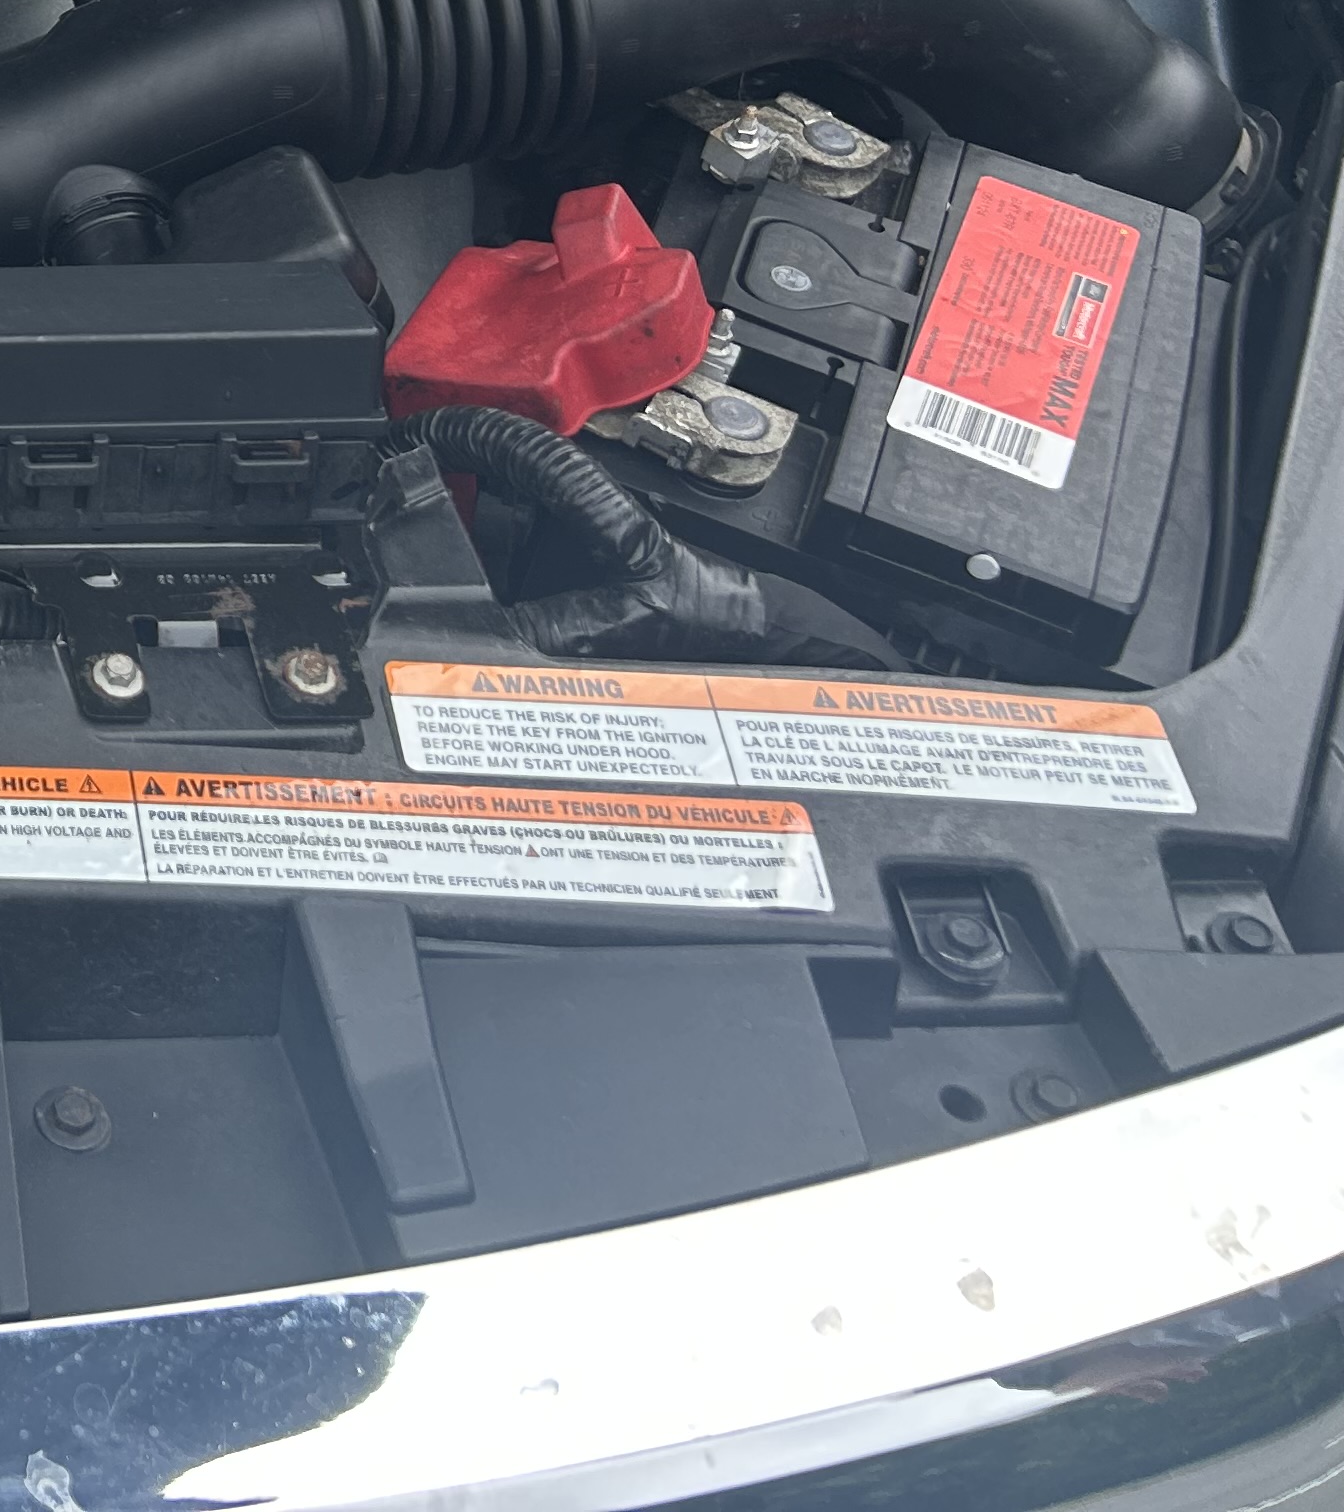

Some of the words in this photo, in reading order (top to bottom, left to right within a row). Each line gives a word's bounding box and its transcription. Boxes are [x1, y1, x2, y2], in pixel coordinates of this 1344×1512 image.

[1040, 375, 1080, 429] MAX
[496, 673, 625, 699] WARNING
[412, 704, 434, 717] TO
[437, 706, 502, 721] REDUCE
[504, 709, 537, 722] THE
[539, 710, 578, 724] RISK
[579, 712, 601, 725] OF
[845, 690, 1057, 724] AVERTISSEMENT
[417, 720, 483, 735] REMOVE
[485, 723, 517, 737] THE
[520, 726, 551, 739] KEY
[555, 727, 601, 741] FROM
[603, 729, 635, 742] THE
[637, 731, 707, 745] IGNITION
[735, 719, 781, 733] POUR
[782, 720, 851, 737] RÉDUIRE
[853, 725, 885, 739] LES
[886, 727, 955, 743] RISQUES
[957, 732, 980, 745] DE
[1079, 741, 1144, 757] RETIRER
[420, 736, 485, 751] BEFORE
[486, 740, 564, 755] WORKING
[566, 743, 622, 758] UNDER
[740, 735, 763, 748] LA
[764, 736, 796, 750] CLÉ
[798, 738, 821, 751] DE
[926, 746, 974, 761] AVANT
[976, 749, 1114, 770] D'ENTREPRENDRE
[1115, 759, 1148, 773] DES
[424, 752, 482, 767] ENGINE
[486, 755, 518, 769] MAY
[522, 757, 572, 771] START
[744, 751, 817, 766] TRAVAUX
[819, 755, 865, 770] SOUS
[866, 758, 888, 772] LE
[952, 763, 974, 776] LE
[975, 765, 1042, 781] MOTEUR
[1043, 769, 1083, 784] PEUT
[1087, 772, 1109, 786] SE
[1110, 774, 1172, 790] METTRE
[750, 767, 773, 780] EN
[775, 768, 844, 784] MARCHE
[175, 778, 376, 805] AVERTISSEMENT
[9, 805, 53, 818] BURN)
[56, 806, 76, 818] OR
[10, 824, 42, 836] HIGH
[43, 825, 102, 838] VOLTAGE
[105, 826, 132, 839] AND
